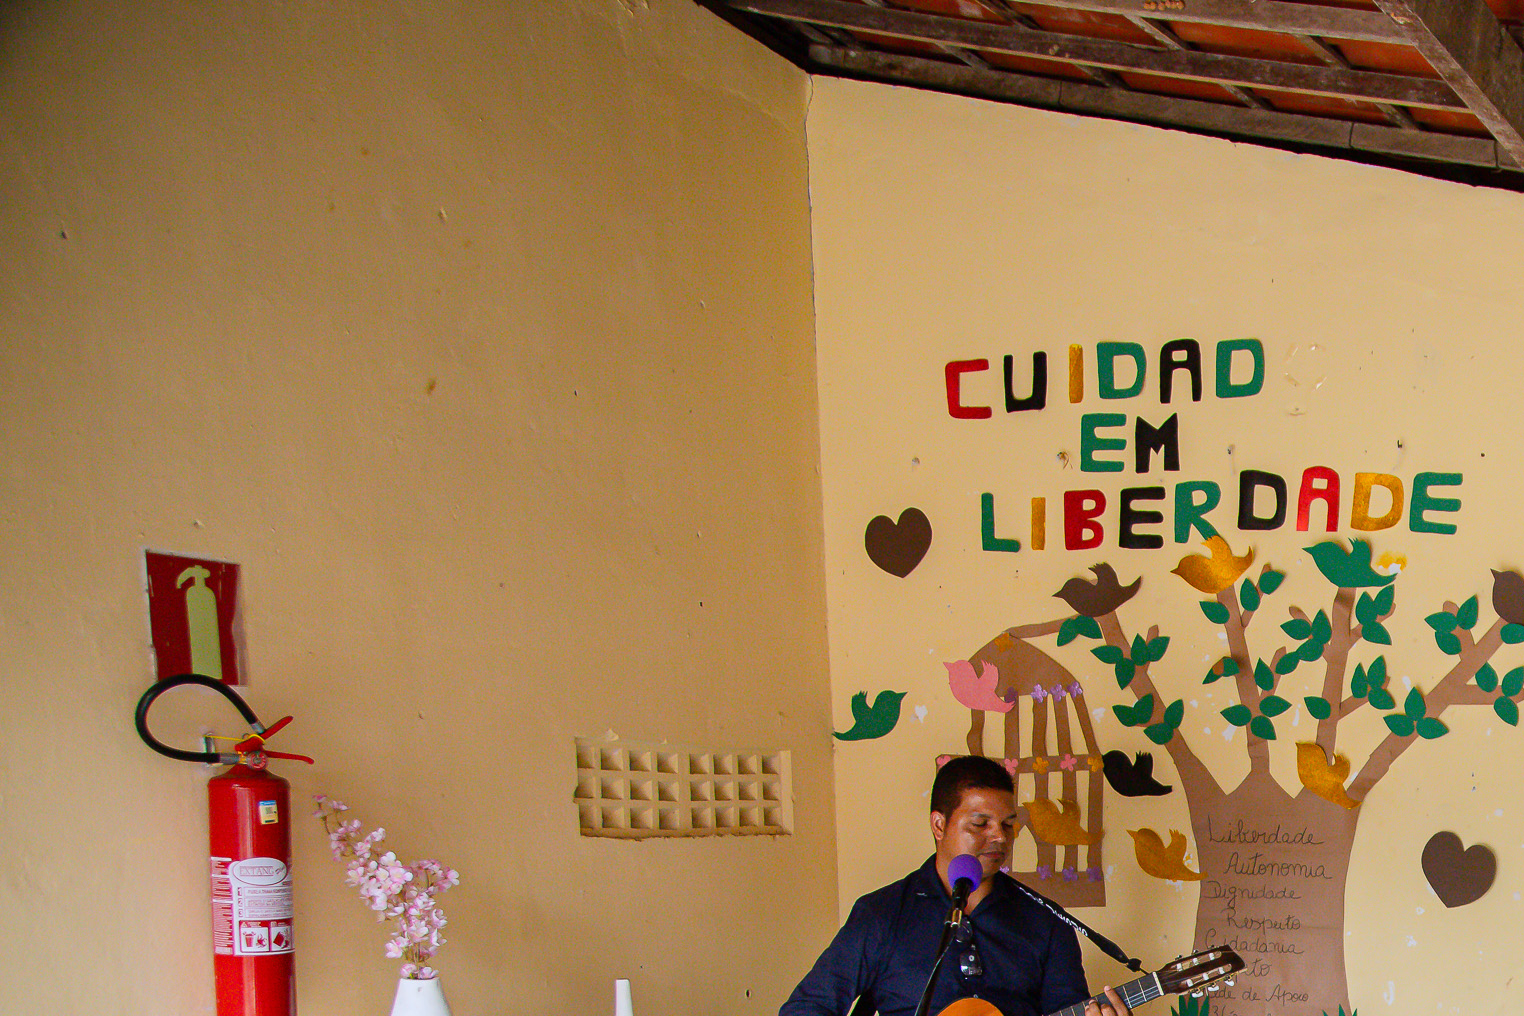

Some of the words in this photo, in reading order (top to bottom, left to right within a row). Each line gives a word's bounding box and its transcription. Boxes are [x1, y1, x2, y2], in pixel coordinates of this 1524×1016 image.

[945, 338, 1265, 420] CUIDAD
[1080, 412, 1180, 473] EM
[981, 465, 1464, 553] LIBERDADE
[1208, 814, 1324, 845] Liberdade
[1223, 852, 1333, 879] Autonomia
[1204, 880, 1302, 908] Dignidade
[1242, 987, 1261, 1001] de
[1265, 983, 1310, 1006] Apoio
